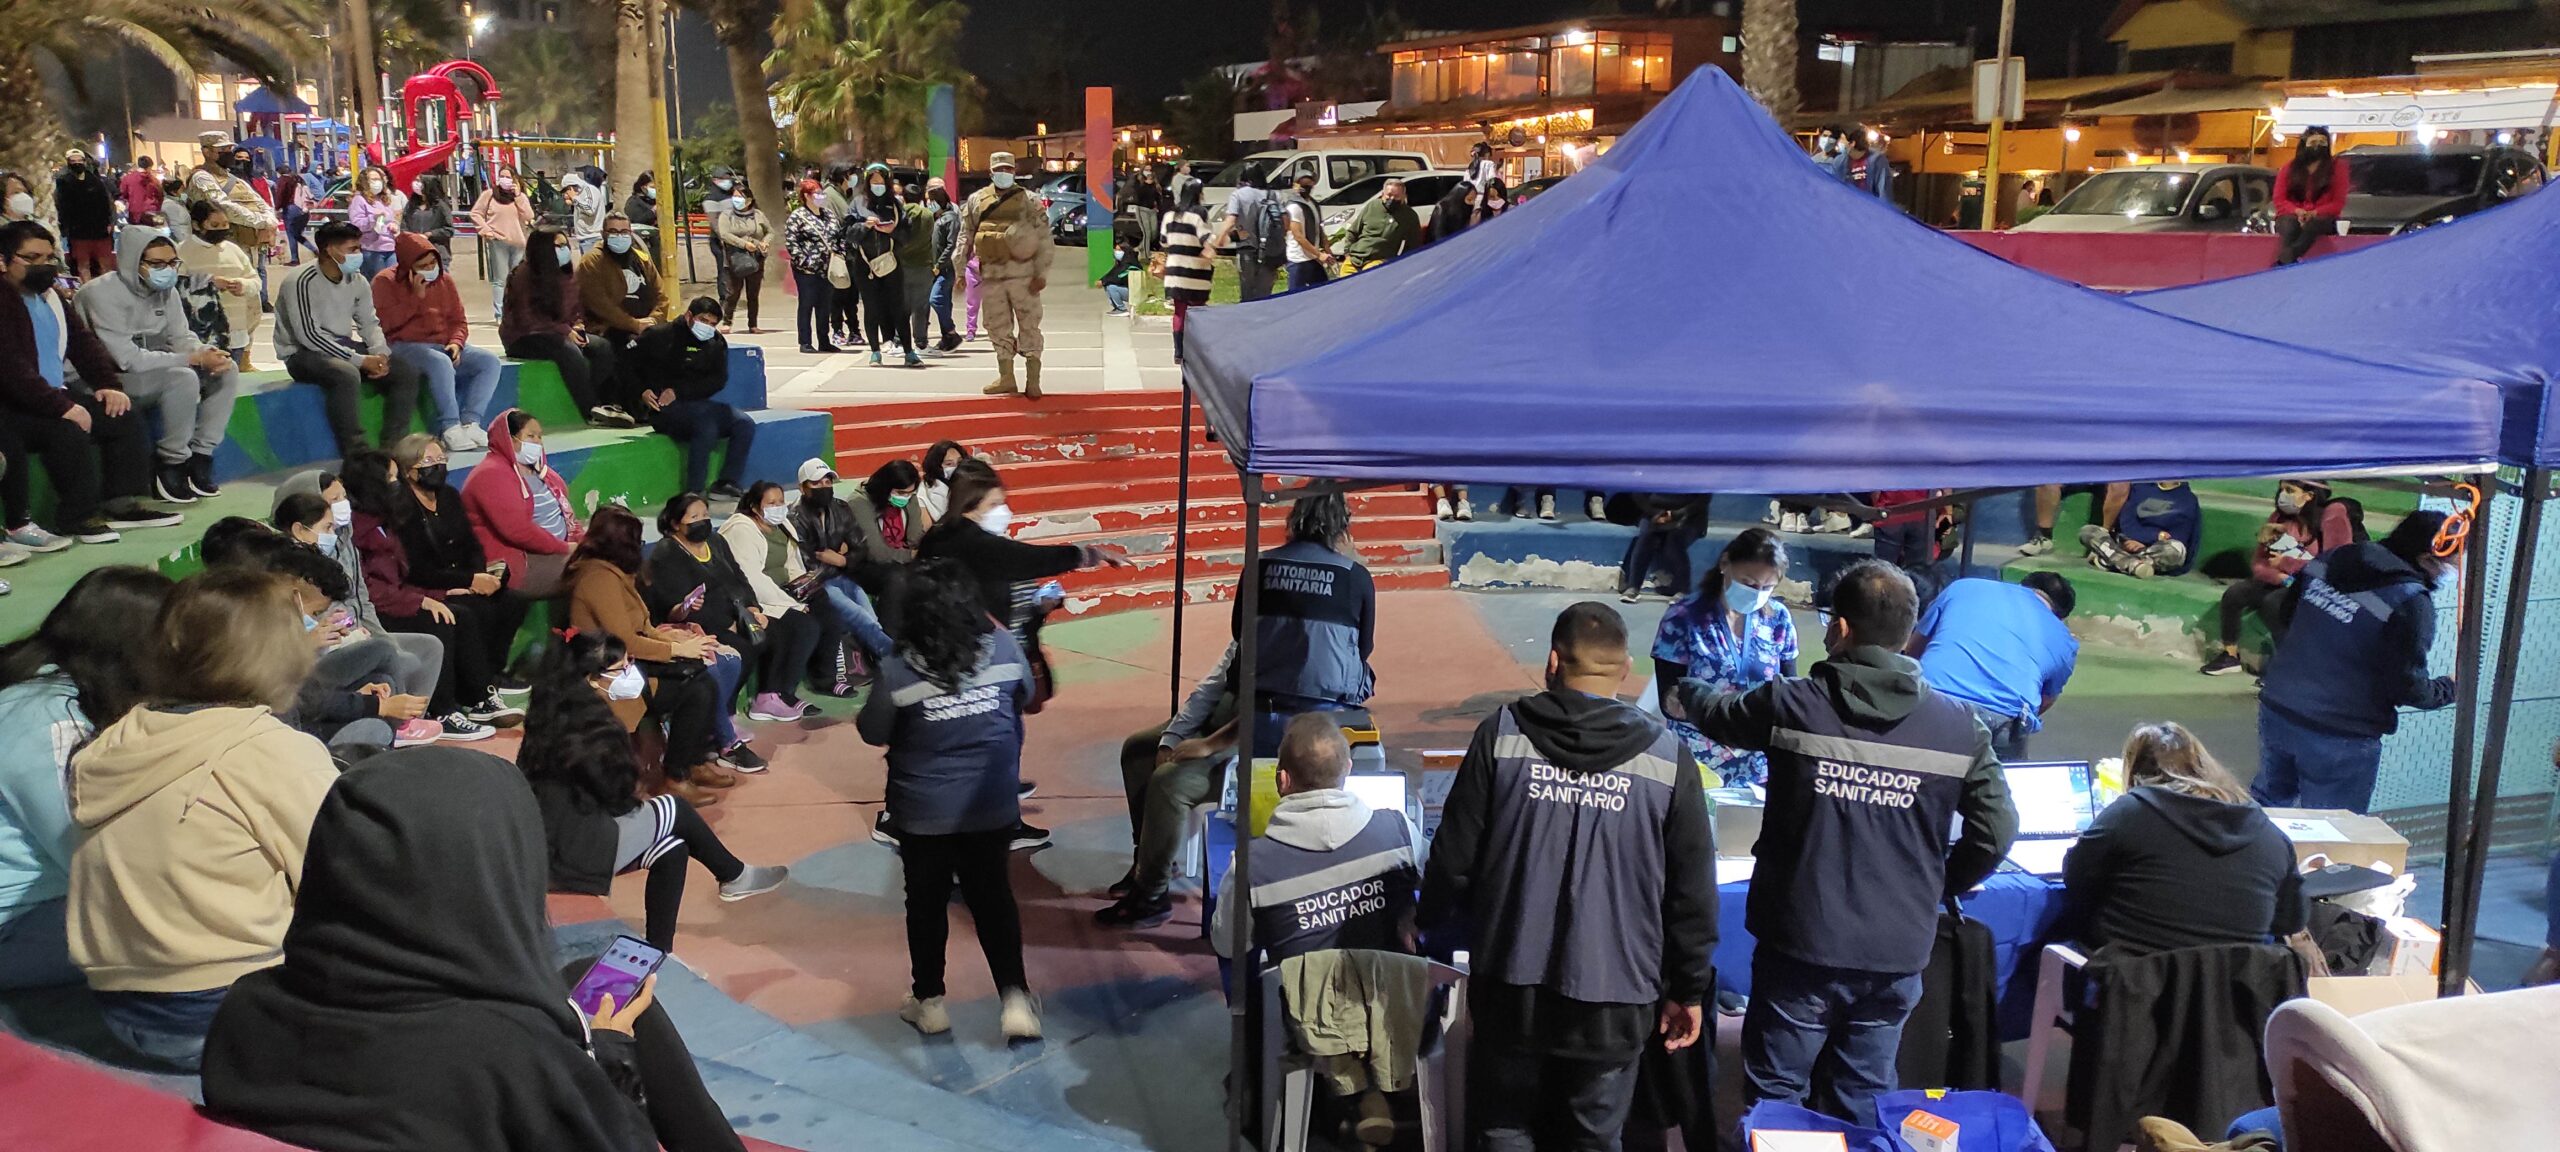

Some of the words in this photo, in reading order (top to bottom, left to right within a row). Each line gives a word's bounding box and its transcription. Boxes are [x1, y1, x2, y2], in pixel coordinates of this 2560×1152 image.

[1263, 577, 1333, 597] SANITARIA
[1264, 564, 1335, 584] AUTORIDAD
[1530, 763, 1632, 795] EDUCADOR
[1817, 760, 1922, 793] EDUCADOR
[1528, 782, 1626, 812] SANITARIO
[1814, 778, 1915, 809] SANITARIO
[1294, 879, 1385, 915] EDUCADOR
[1298, 895, 1387, 930] SANITARIO
